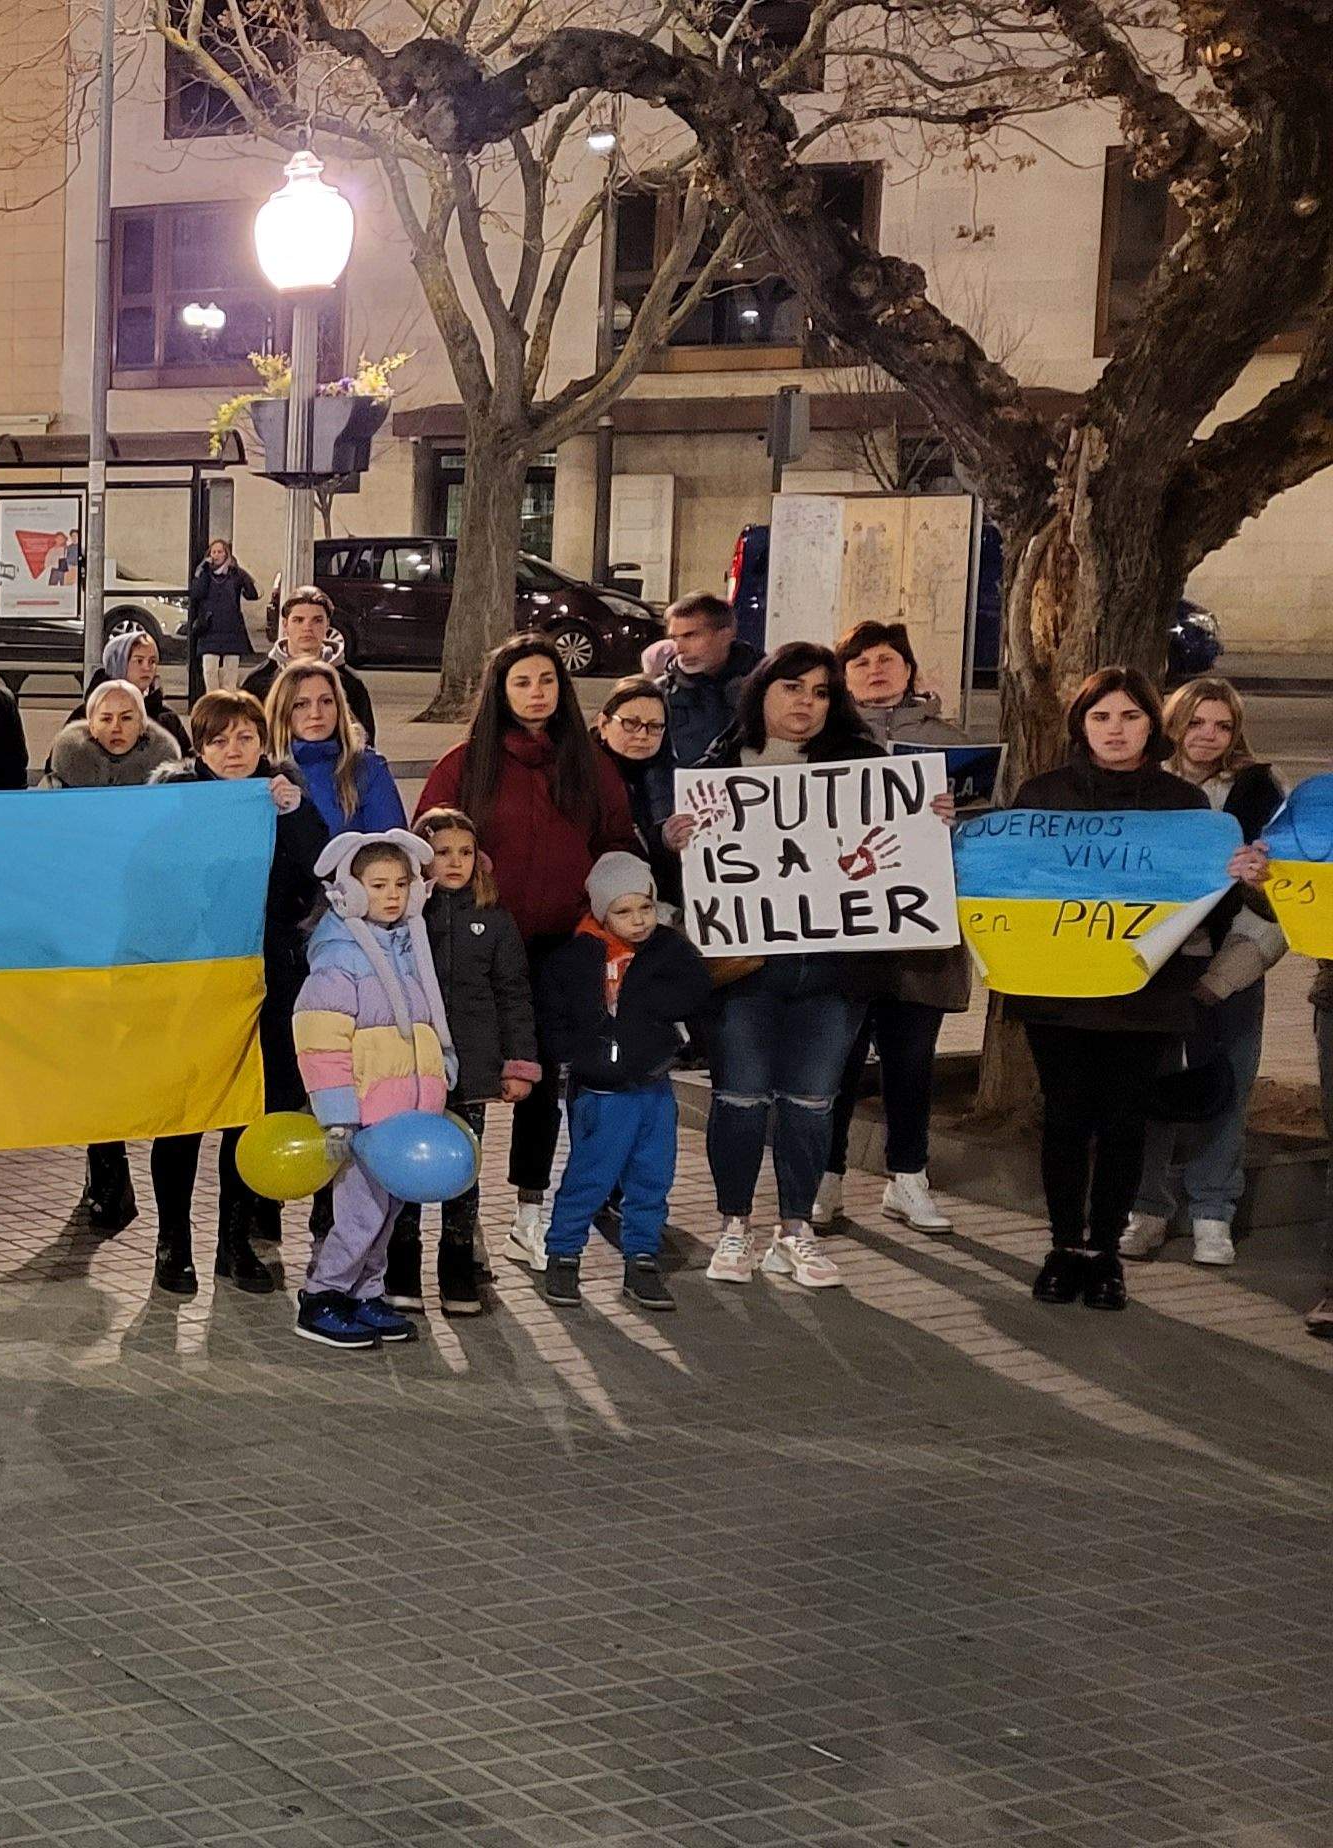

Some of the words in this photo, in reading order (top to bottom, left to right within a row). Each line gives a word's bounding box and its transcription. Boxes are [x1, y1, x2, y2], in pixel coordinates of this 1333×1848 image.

[724, 760, 927, 832] PUTIN
[961, 812, 1125, 840] QUEREMOS
[703, 843, 761, 884] IS
[777, 838, 812, 879] A
[693, 885, 941, 946] KILLER
[969, 911, 1011, 934] en
[1052, 900, 1157, 941] PAZ
